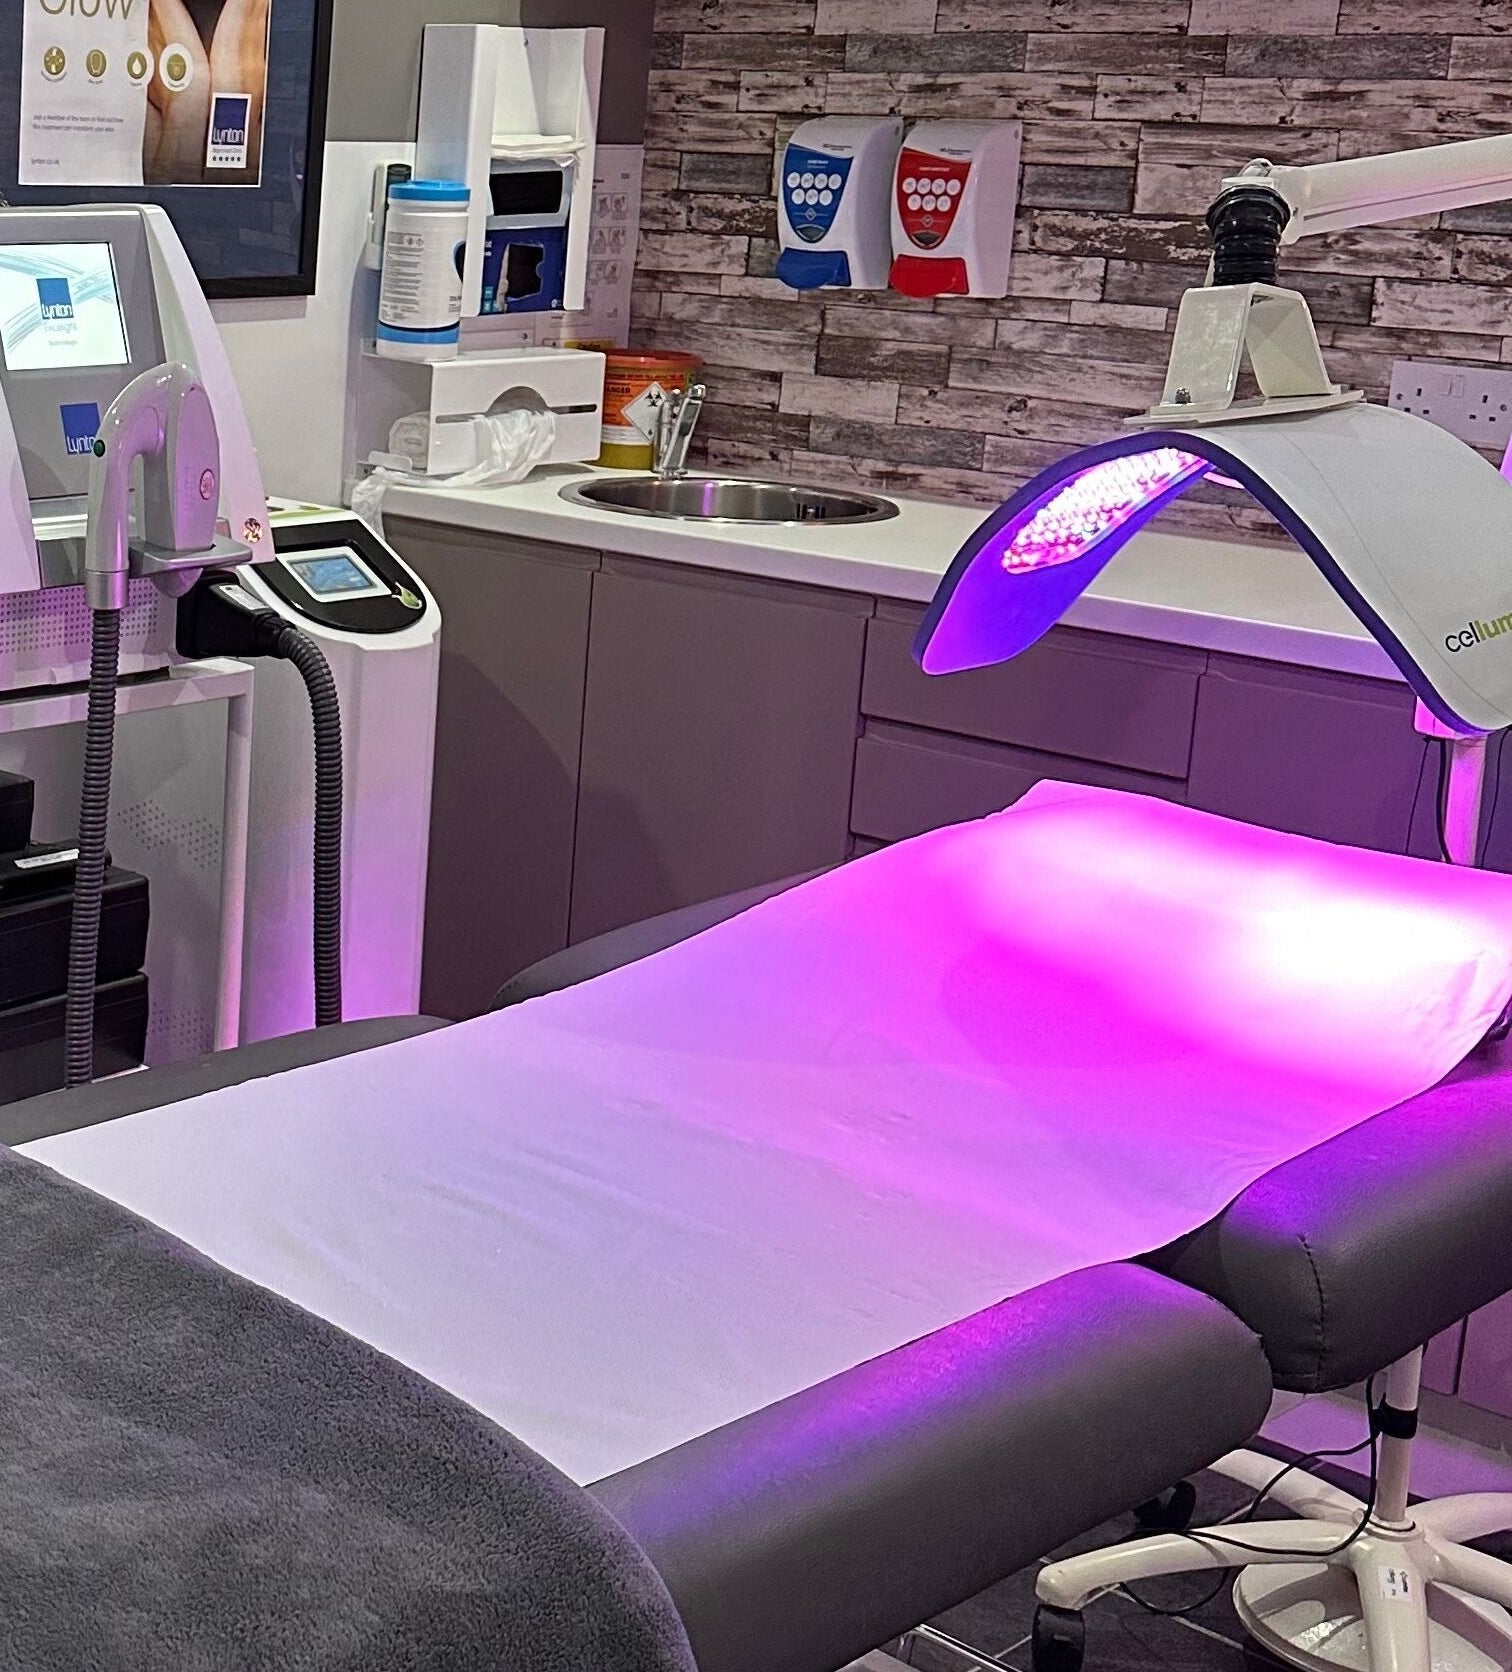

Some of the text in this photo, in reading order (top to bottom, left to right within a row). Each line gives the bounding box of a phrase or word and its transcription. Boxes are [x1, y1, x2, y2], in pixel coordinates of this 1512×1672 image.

[212, 126, 244, 145] Lynton
[41, 303, 73, 319] Lynton
[67, 435, 95, 454] Lynto
